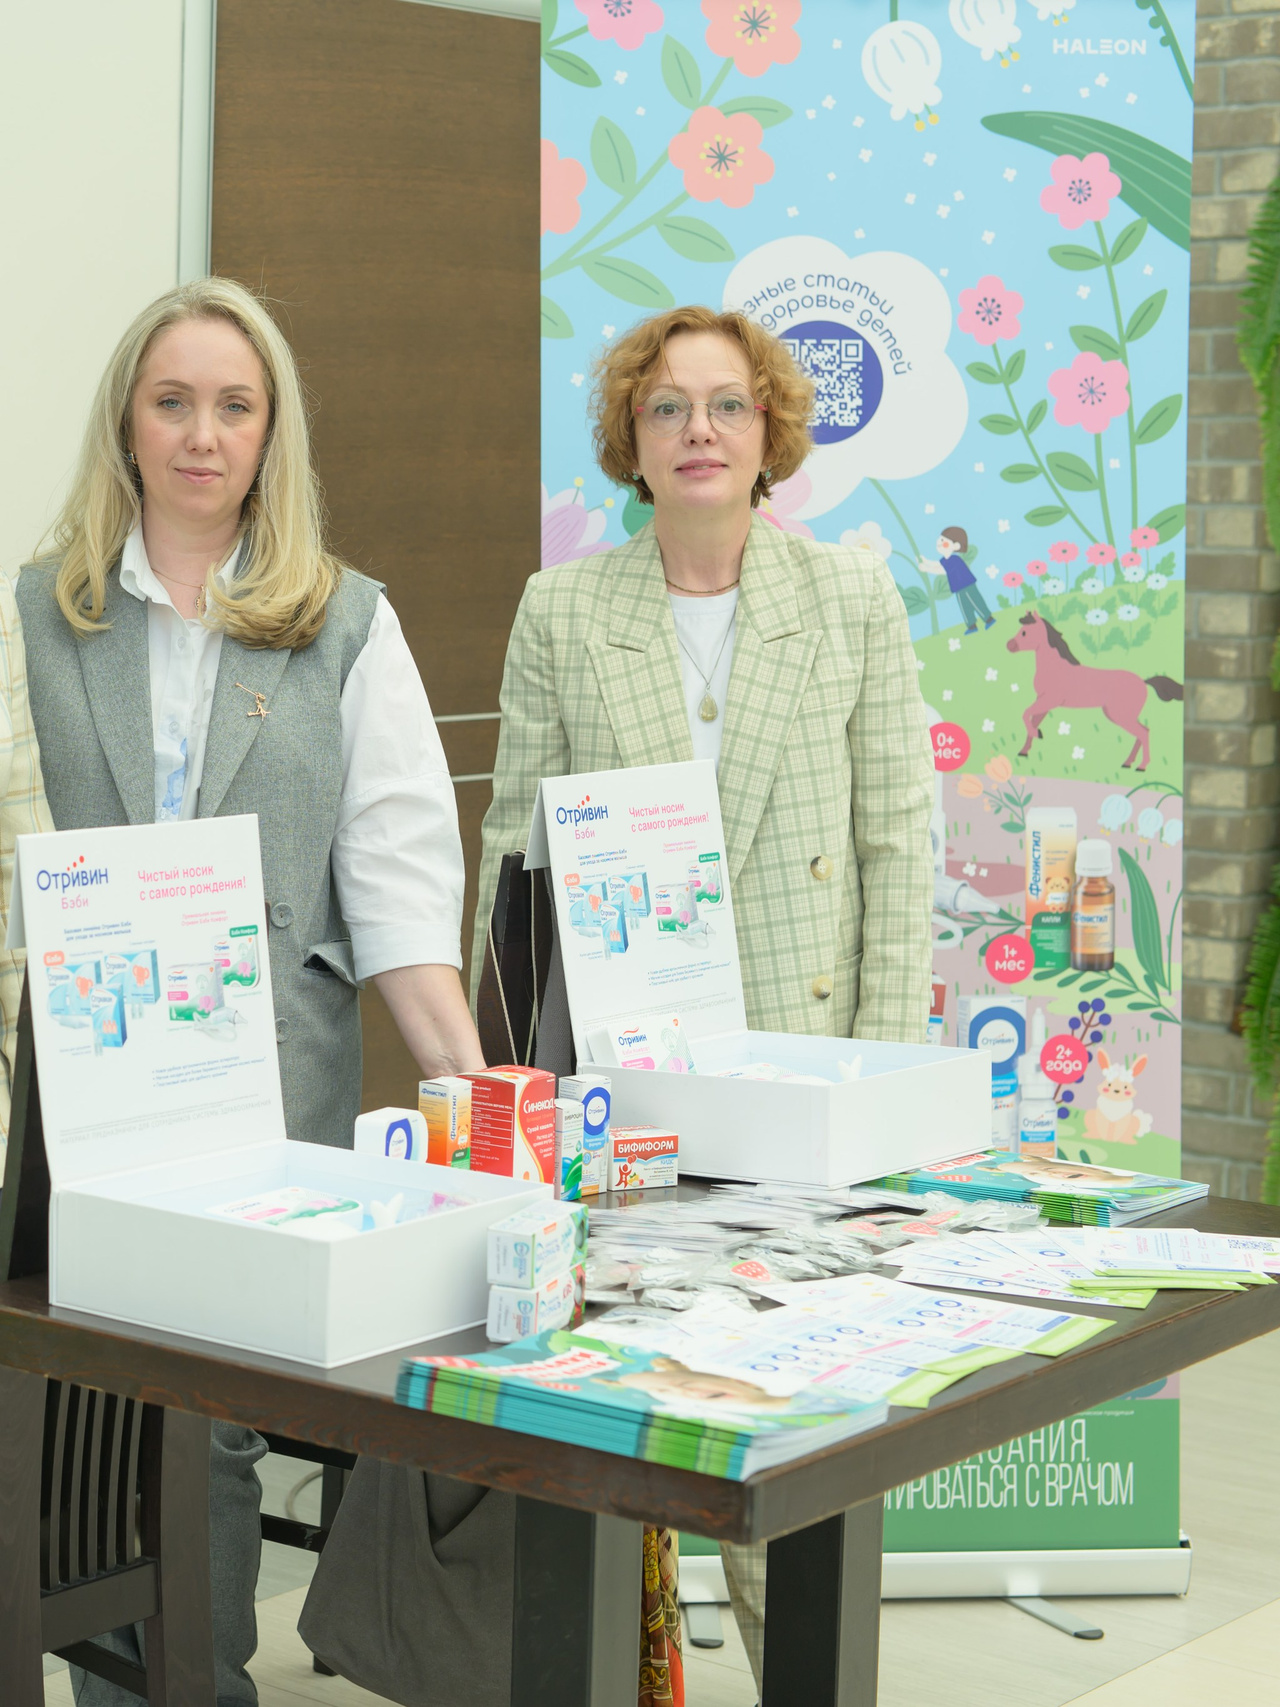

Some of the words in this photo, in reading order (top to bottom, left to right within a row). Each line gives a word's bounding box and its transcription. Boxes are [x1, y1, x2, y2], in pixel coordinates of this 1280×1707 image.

[1052, 38, 1147, 55] HALEON
[803, 274, 894, 316] статьи
[760, 294, 855, 331] доровье
[856, 309, 913, 376] детей
[936, 732, 955, 747] 0+
[556, 804, 609, 826] Отривин
[628, 804, 660, 818] Чистый
[661, 802, 685, 814] носик
[631, 823, 637, 832] с
[637, 820, 666, 832] самого
[667, 812, 710, 830] рождения!
[574, 827, 596, 840] Бэби
[1028, 830, 1042, 899] Фенистил
[37, 867, 109, 894] Отривин
[137, 866, 180, 883] Чистый
[182, 865, 214, 878] носик
[139, 889, 146, 901] с
[148, 886, 187, 900] самого
[189, 876, 246, 898] рождения!
[61, 893, 89, 910] Бэби
[1002, 944, 1018, 960] 1+
[994, 958, 1026, 973] мес
[618, 1033, 648, 1048] Отривин
[981, 1036, 1015, 1046] Отривин
[1056, 1045, 1073, 1060] 2+
[1045, 1058, 1083, 1073] года
[421, 1088, 447, 1098] Фенистил
[1022, 1117, 1053, 1128] Отривин
[618, 1140, 675, 1154] БИФИФОРМ
[1025, 1463, 1040, 1508] С
[1045, 1462, 1134, 1507] ВРАЧОМ
